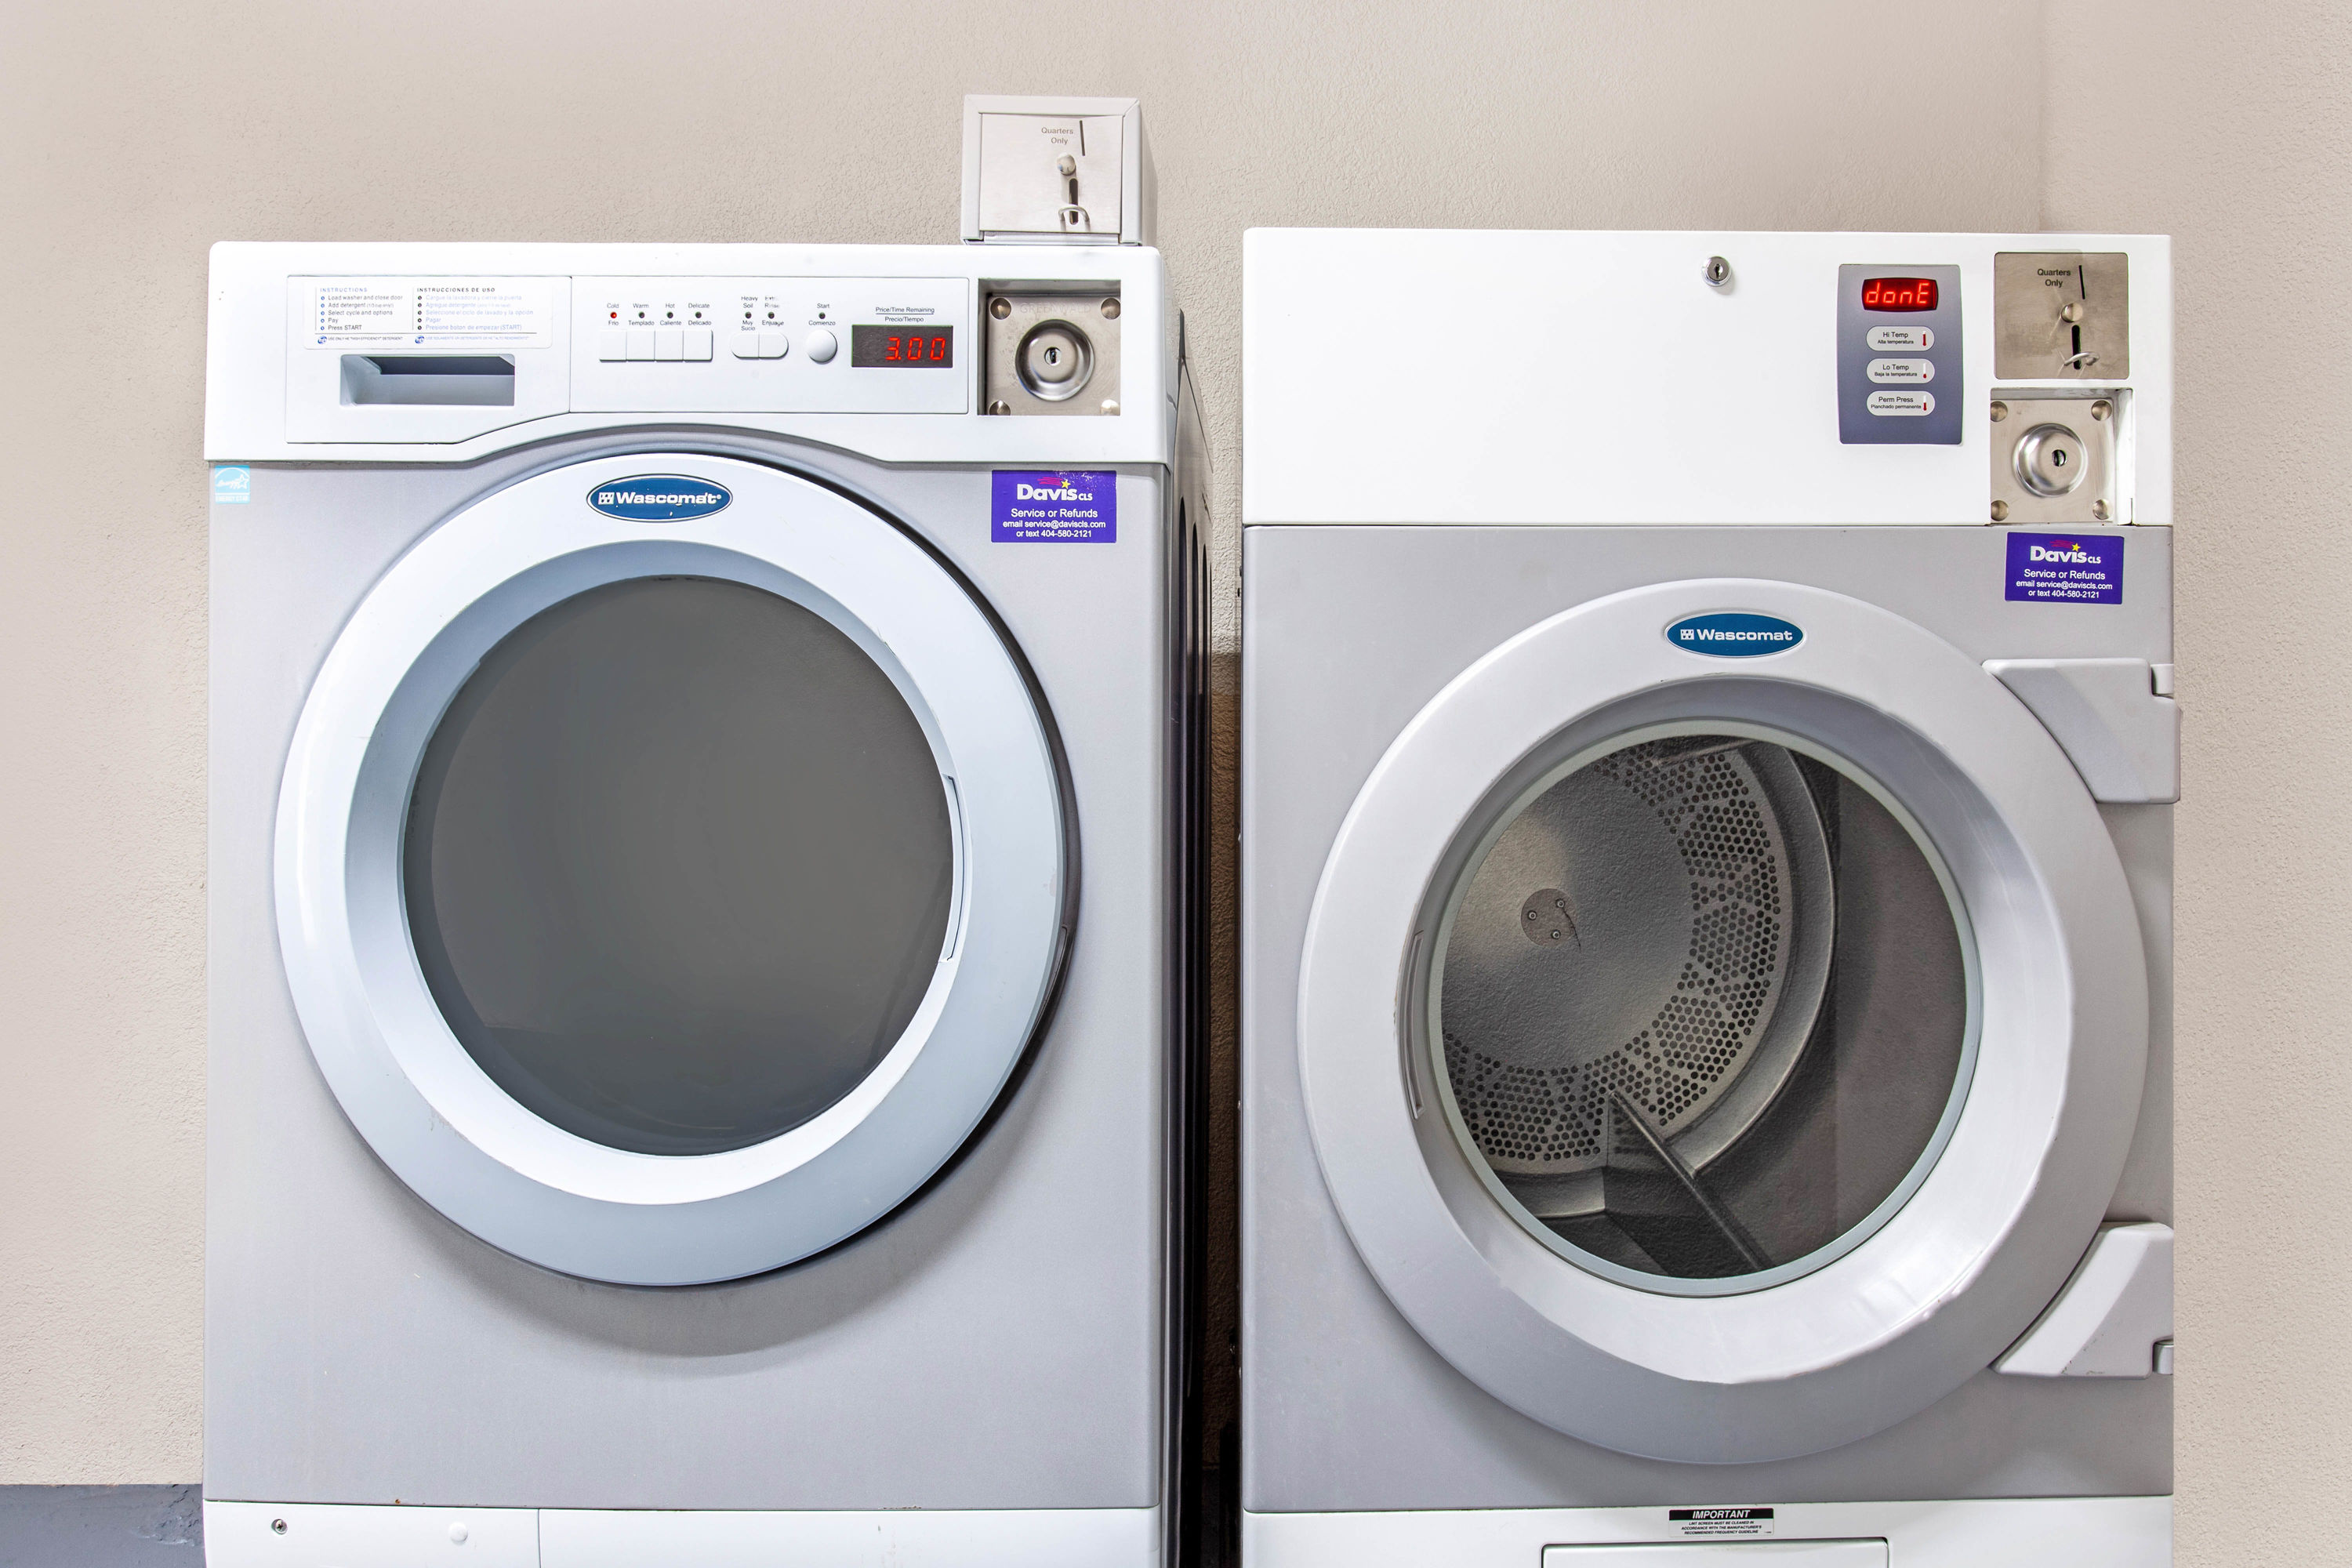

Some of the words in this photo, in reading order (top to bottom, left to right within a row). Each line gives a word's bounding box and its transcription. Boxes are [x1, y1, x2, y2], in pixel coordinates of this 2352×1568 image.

[2045, 279, 2063, 288] Only
[1020, 303, 1091, 314] GREENWALD
[886, 337, 946, 360] 3.00
[1017, 484, 1077, 501] Davis
[1011, 508, 1045, 517] Service
[1059, 509, 1098, 517] Refunds
[1024, 521, 1106, 529] service@daviscls.com
[2030, 546, 2087, 564] Davis
[2024, 568, 2056, 579] Service
[2070, 571, 2106, 580] Refunds
[2036, 581, 2113, 590] service@daviscls.com
[2051, 590, 2100, 598] 404-580-2121
[1697, 629, 1793, 641] Wascomat
[1693, 1510, 1751, 1519] IMPORTANT
